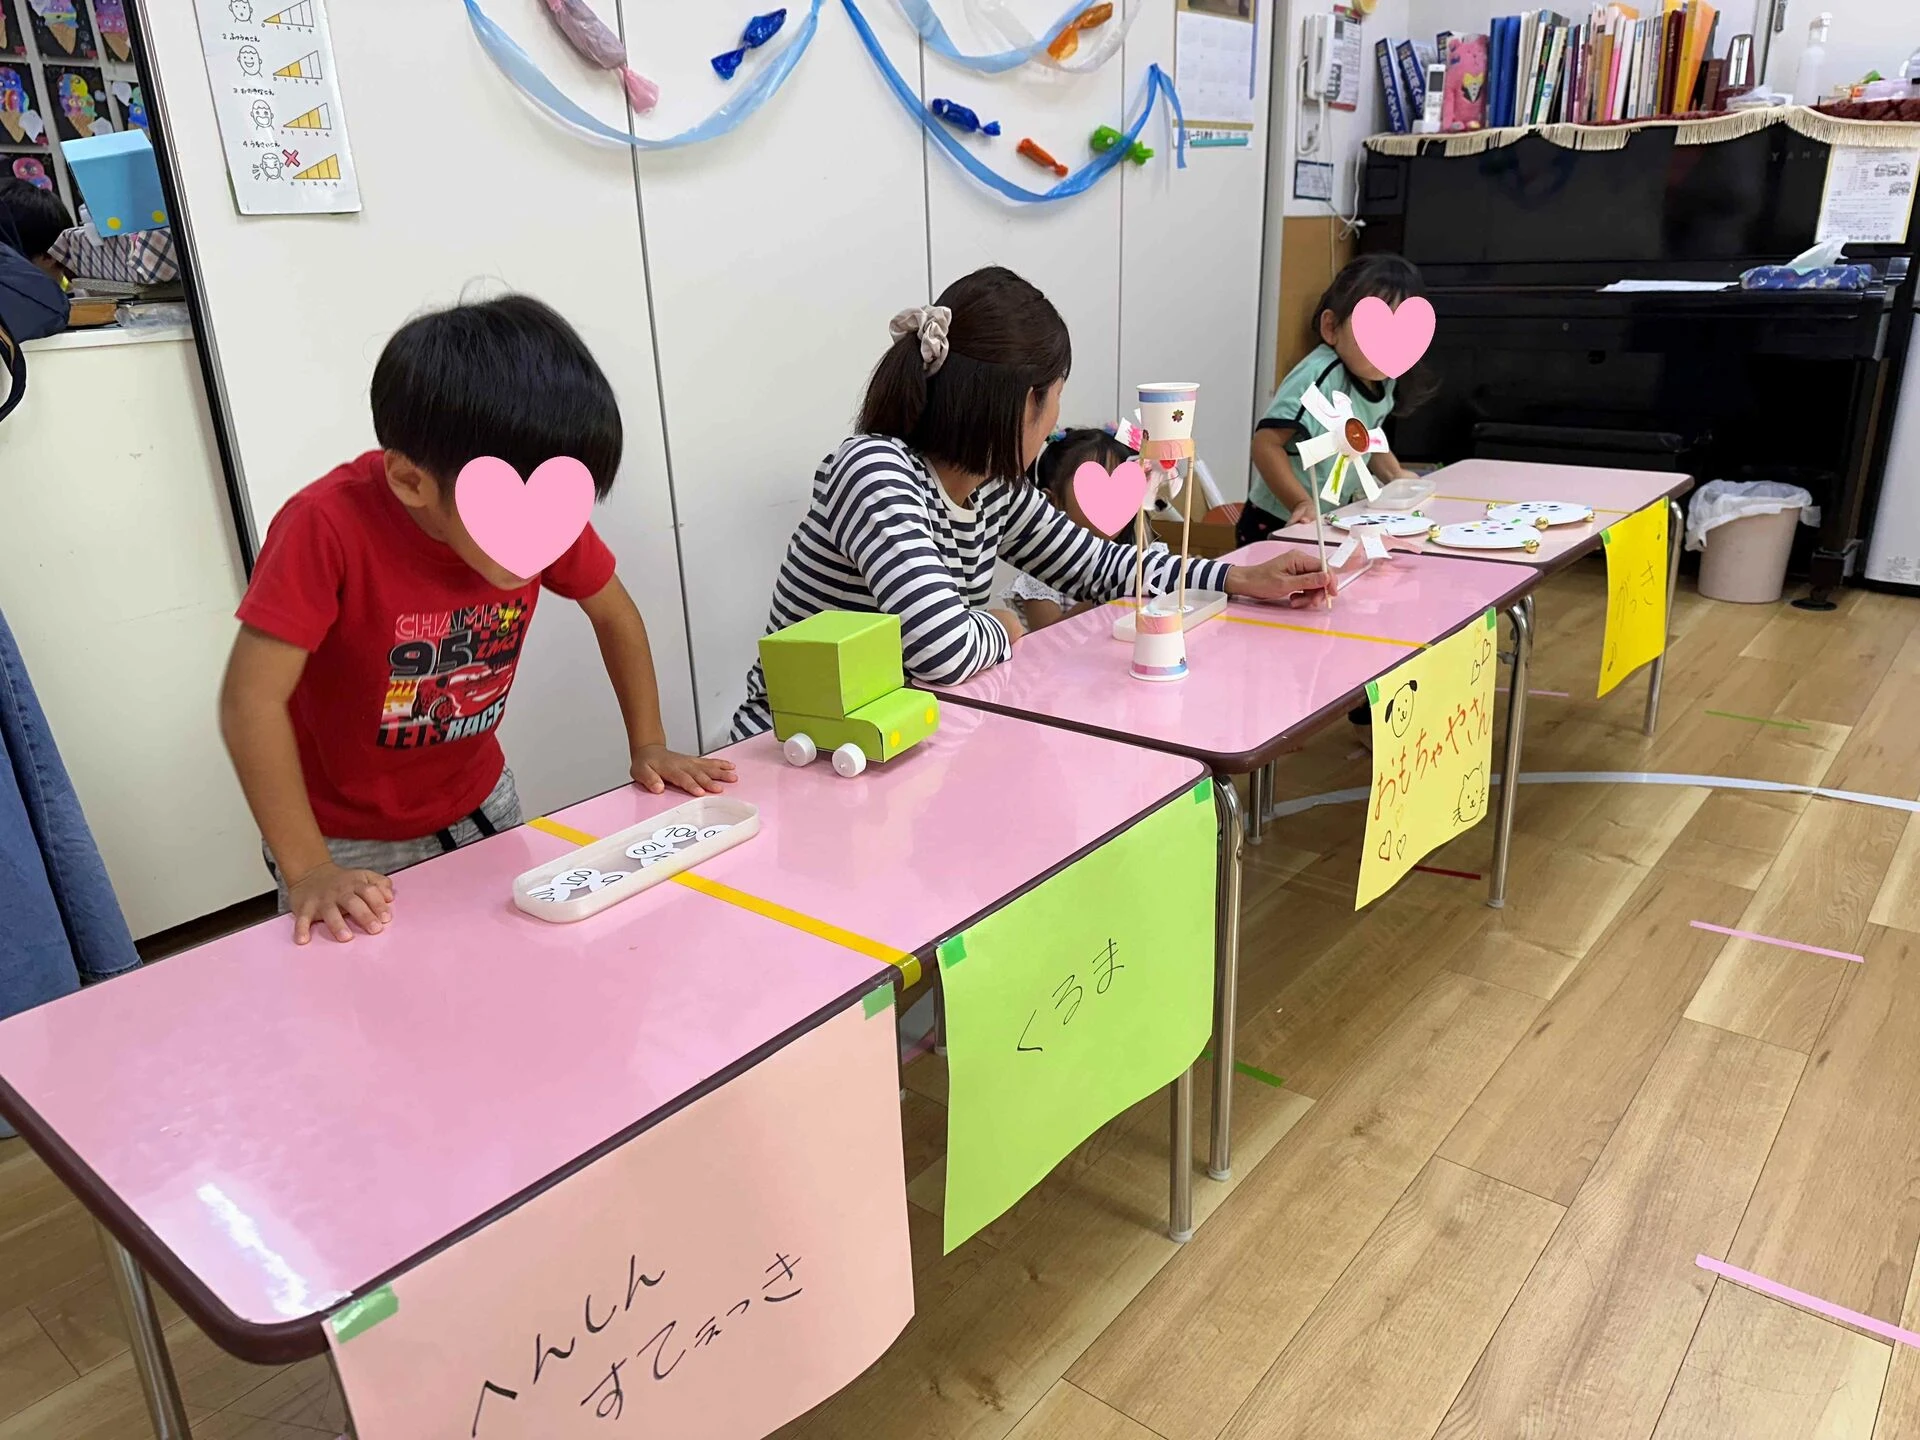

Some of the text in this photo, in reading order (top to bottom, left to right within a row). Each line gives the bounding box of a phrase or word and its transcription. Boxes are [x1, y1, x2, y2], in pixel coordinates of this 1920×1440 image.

[389, 629, 472, 679] 95
[1375, 692, 1491, 821] おもちゃやさん
[1017, 938, 1124, 1052] くるま
[472, 1253, 666, 1438] へんしん
